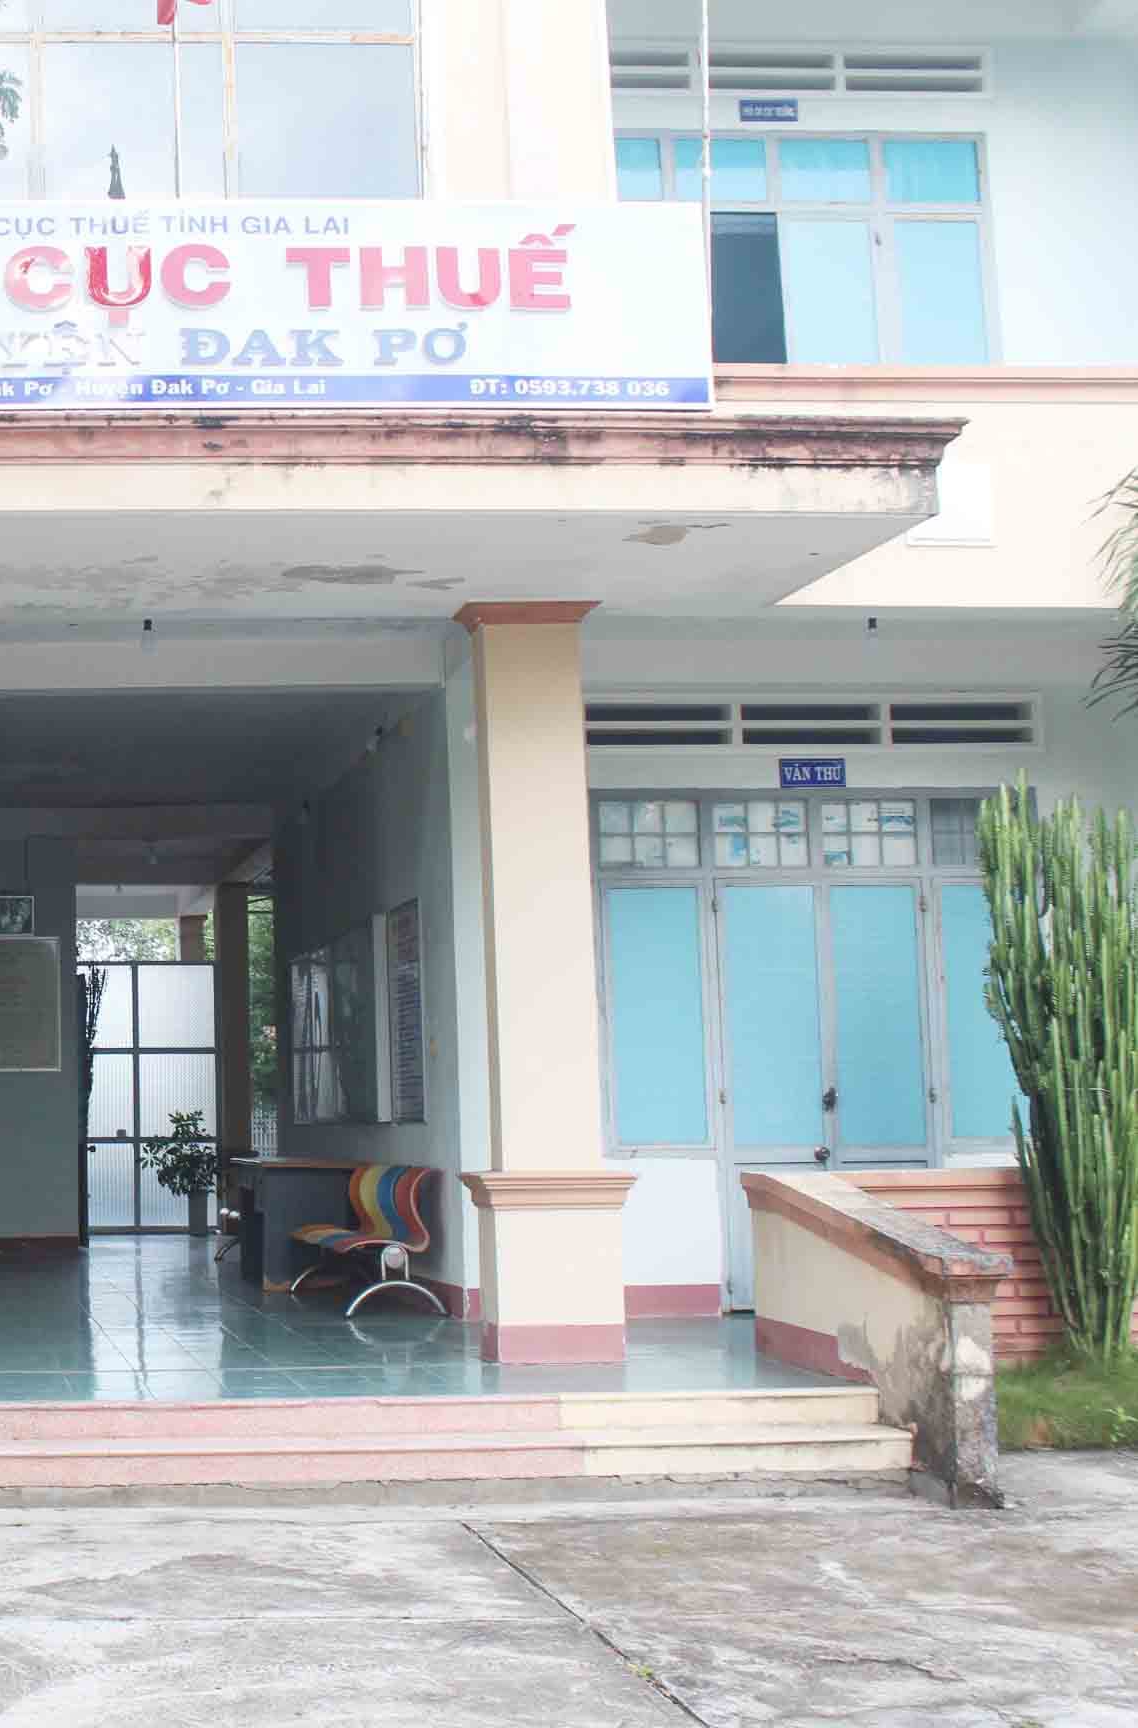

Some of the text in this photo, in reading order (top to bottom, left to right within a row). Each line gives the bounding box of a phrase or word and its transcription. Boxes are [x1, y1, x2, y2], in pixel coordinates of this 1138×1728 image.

[70, 208, 151, 237] THUẾ
[240, 215, 292, 236] GIA
[304, 215, 350, 235] LAI
[4, 243, 231, 327] CỤC
[285, 223, 576, 312] THUẾ
[178, 327, 345, 368] ĐAK
[372, 321, 469, 367] PƠ
[24, 379, 55, 398] Pơ
[150, 378, 194, 397] Đak
[200, 378, 232, 397] Pơ
[250, 378, 287, 397] Gia
[292, 378, 326, 396] Lai
[513, 379, 621, 397] 0593.738
[625, 380, 671, 398] 036
